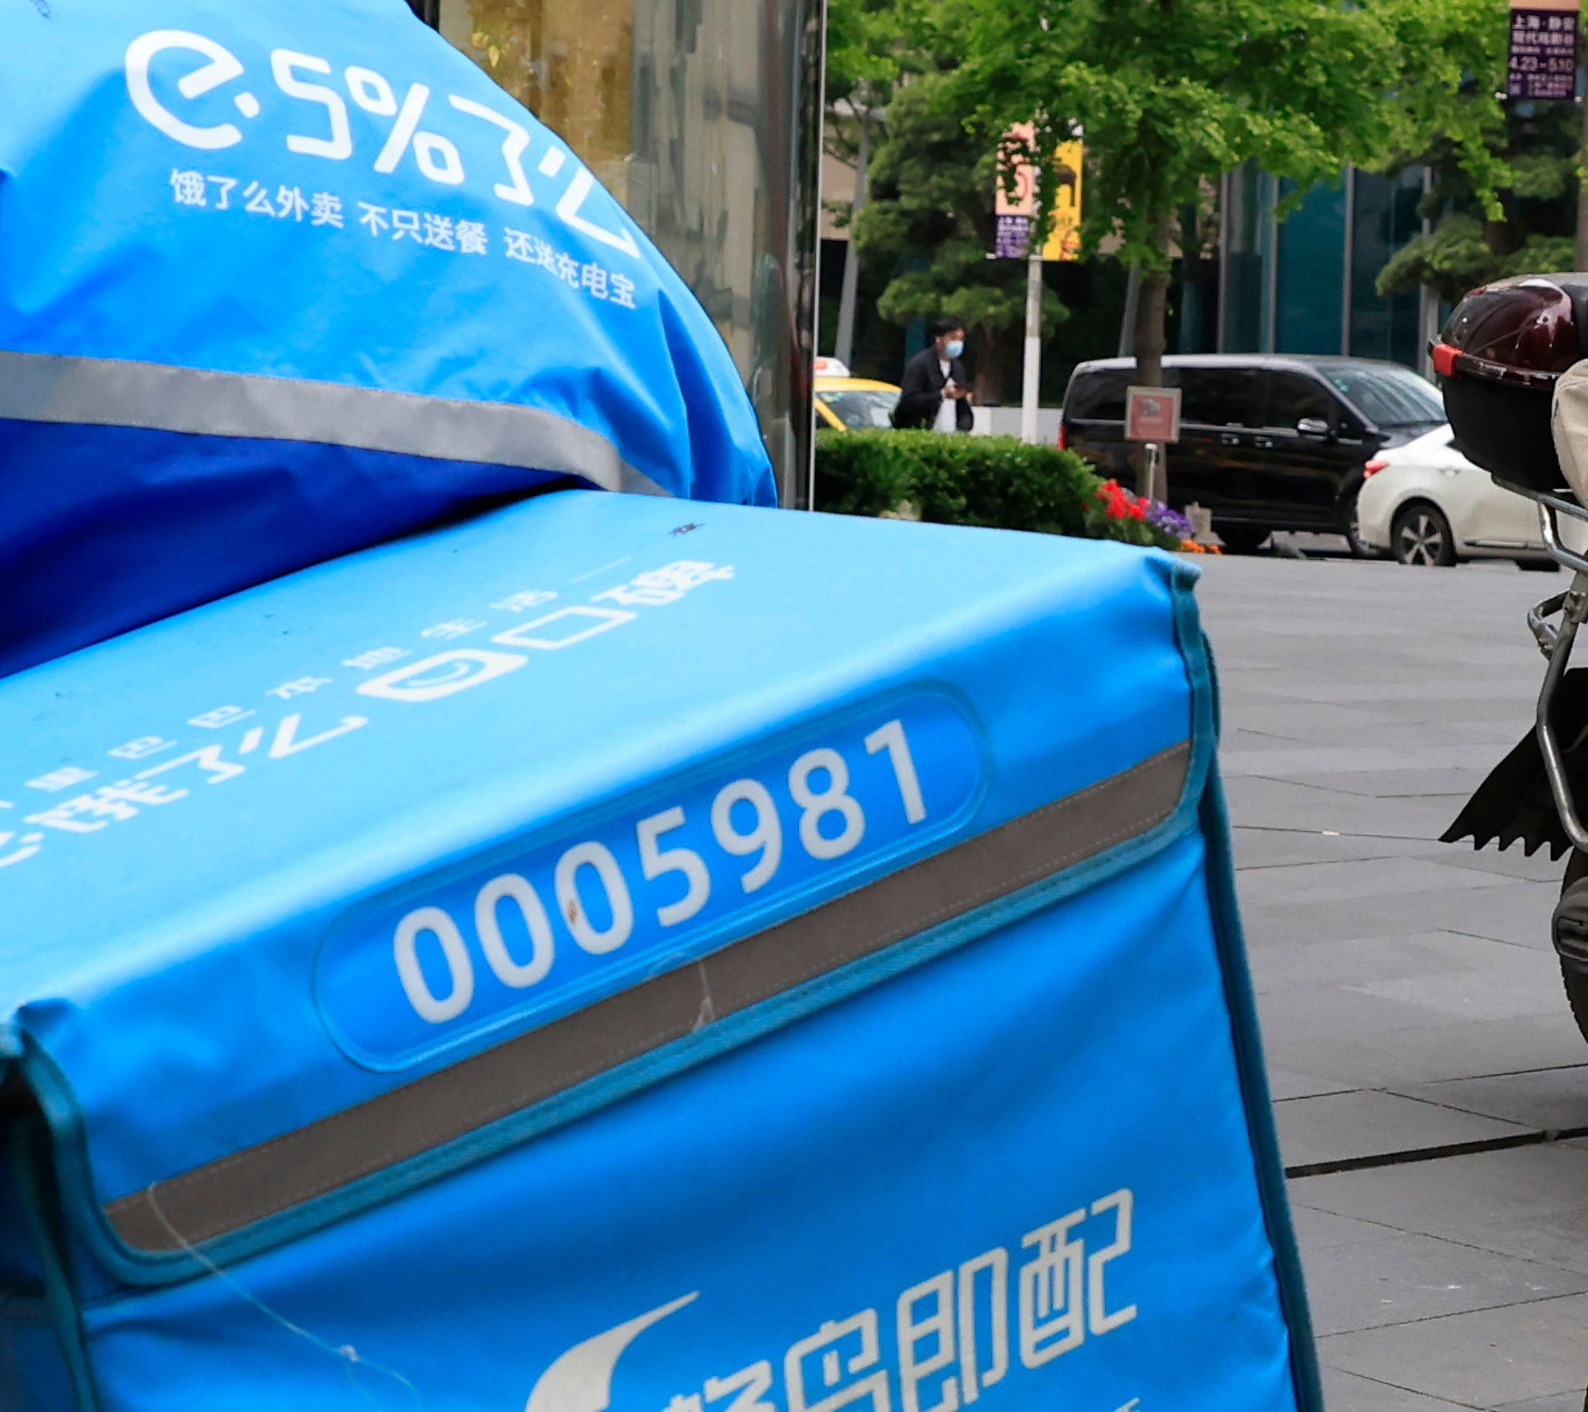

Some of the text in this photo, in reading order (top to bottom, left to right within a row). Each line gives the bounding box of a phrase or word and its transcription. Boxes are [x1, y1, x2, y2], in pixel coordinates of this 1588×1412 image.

[170, 167, 636, 310] 饿了么外卖 不只送餐 还送充电宝
[393, 720, 931, 1028] 0005981
